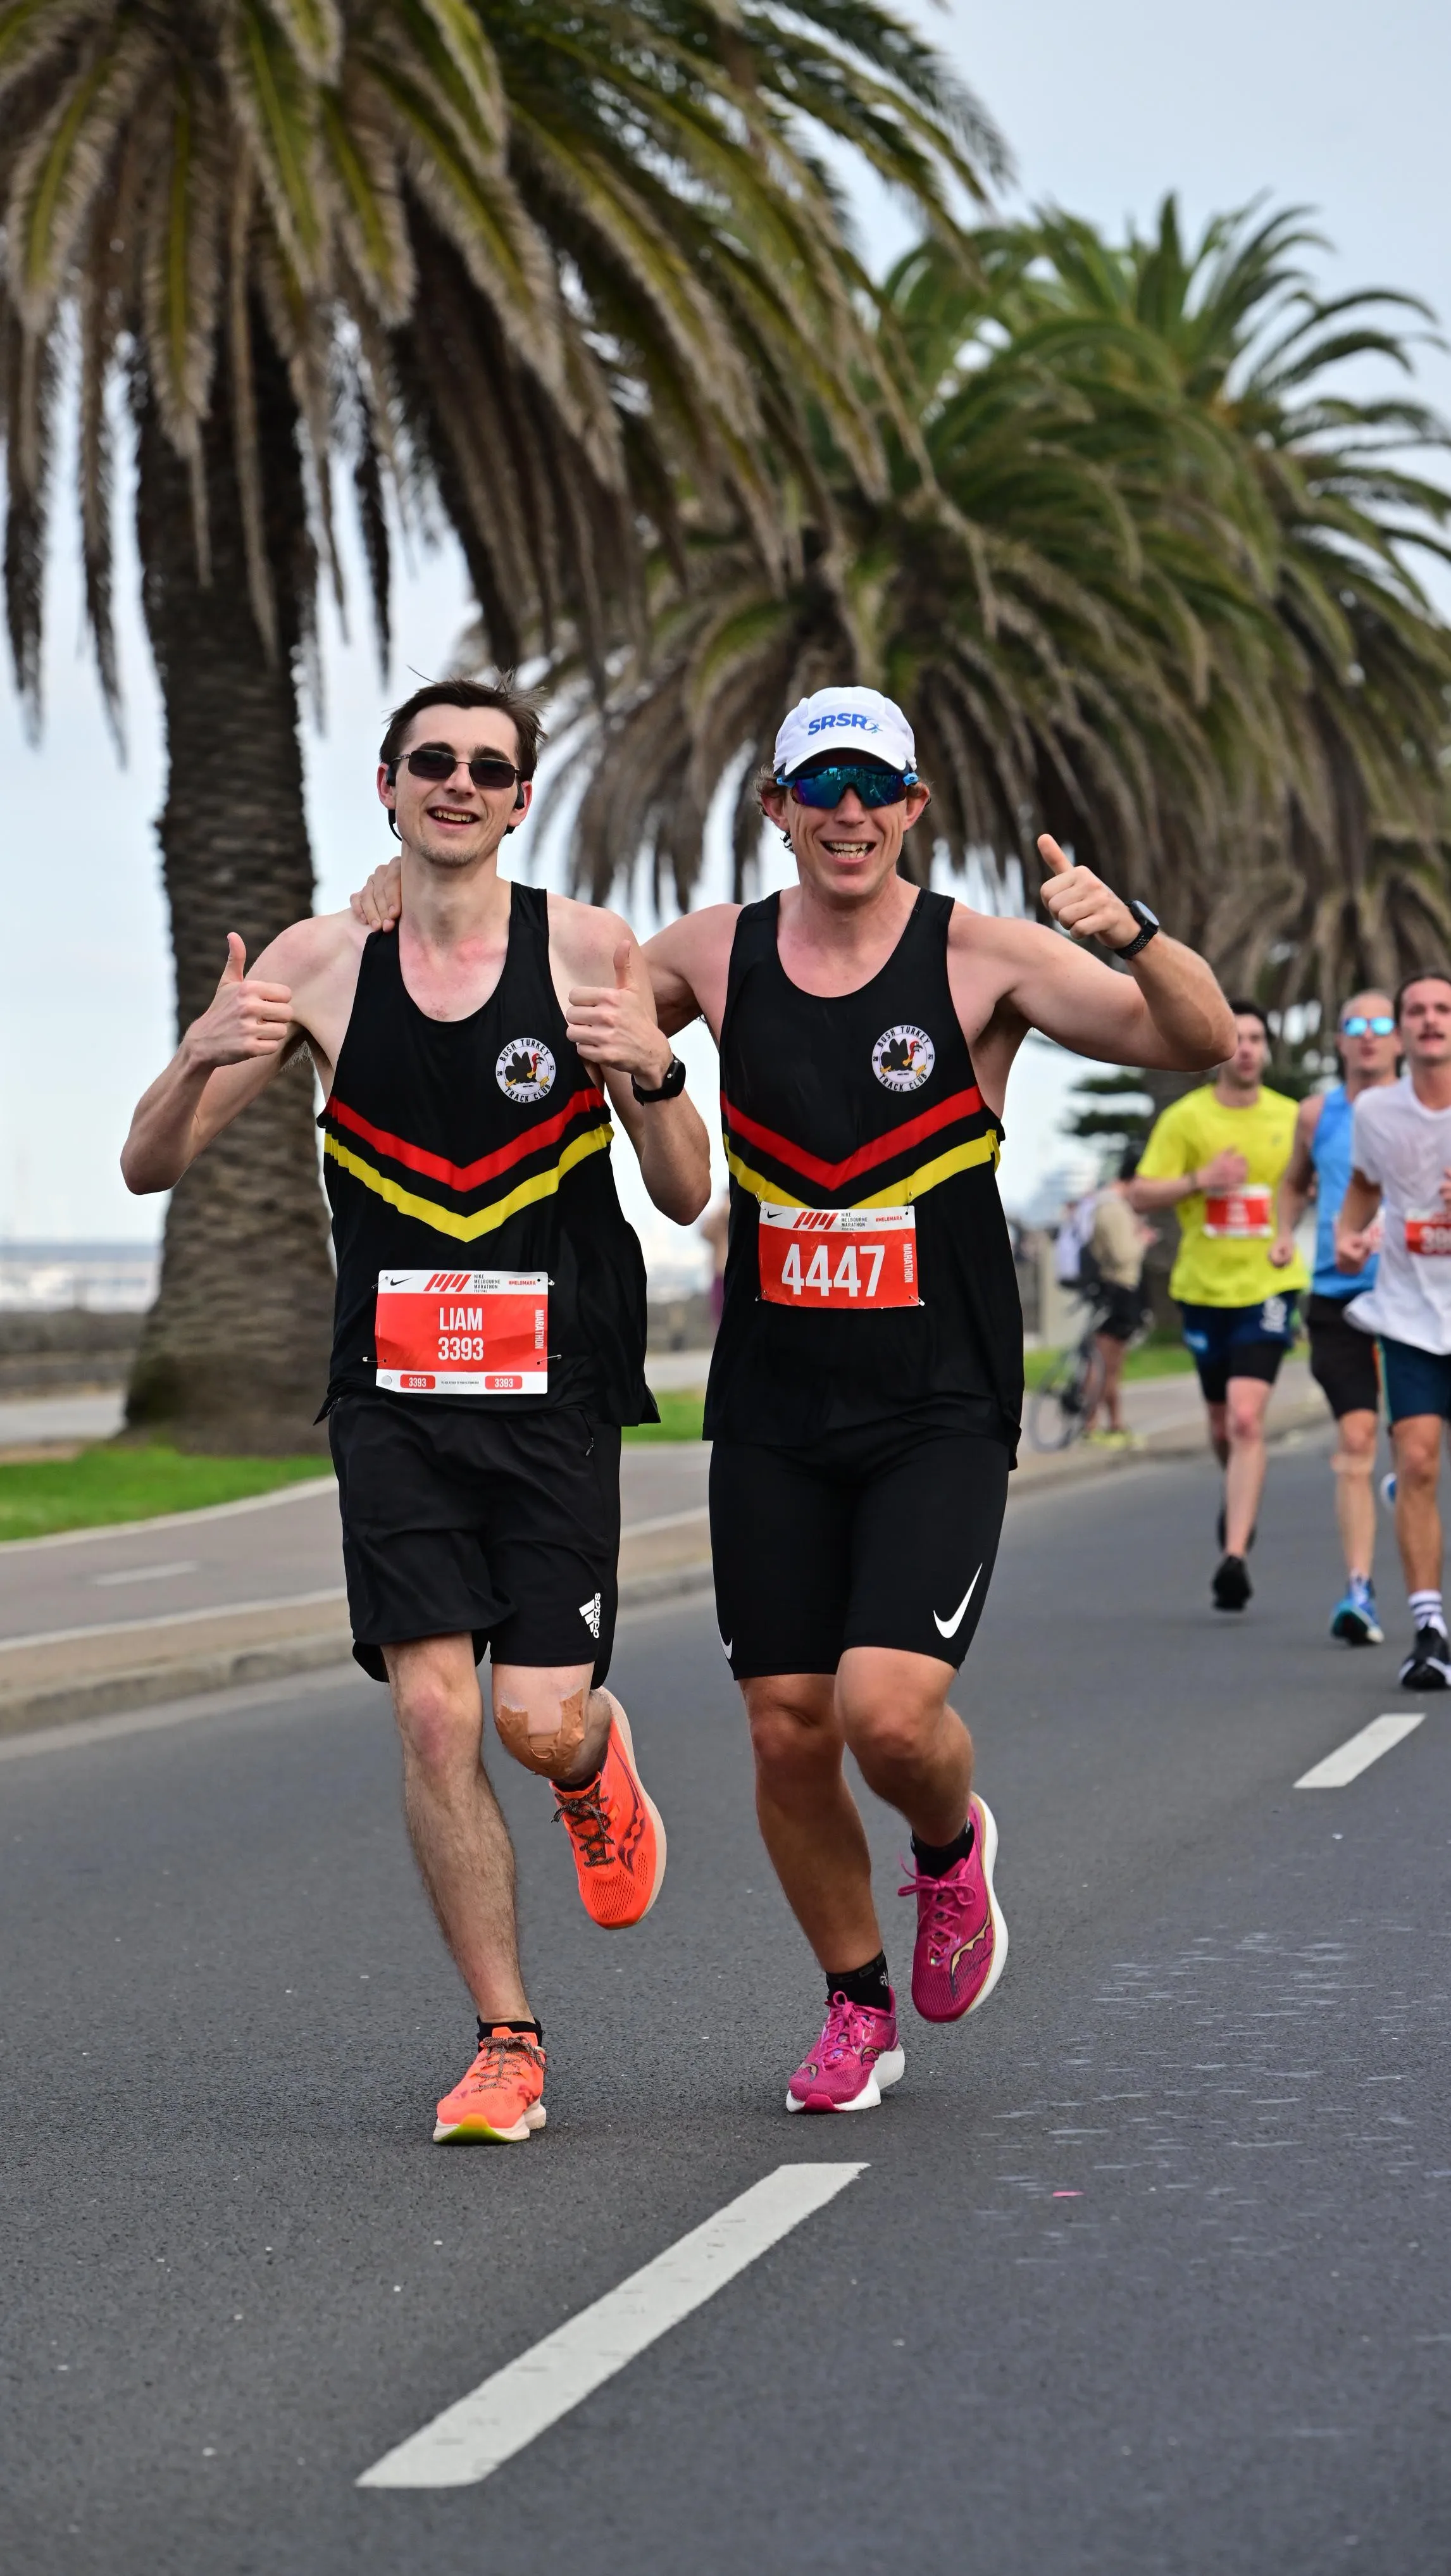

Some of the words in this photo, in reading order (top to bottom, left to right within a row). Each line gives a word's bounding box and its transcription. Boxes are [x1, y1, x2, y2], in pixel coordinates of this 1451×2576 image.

[807, 713, 868, 735] SRSR
[877, 1029, 895, 1047] BUSH
[900, 1026, 930, 1044] TURKEY
[499, 1042, 516, 1061] BUSH
[520, 1039, 550, 1056] TURKEY
[505, 1087, 529, 1102] TRACK
[533, 1084, 551, 1099] CLUB
[879, 1073, 904, 1091] TRACK
[909, 1073, 928, 1089] CLUB
[782, 1243, 885, 1297] 4447
[903, 1243, 914, 1283] MARATHON
[439, 1308, 483, 1331] LIAM
[535, 1310, 544, 1349] MARATHON
[438, 1337, 484, 1361] 3393
[409, 1377, 427, 1387] 3393
[494, 1378, 513, 1388] 3393
